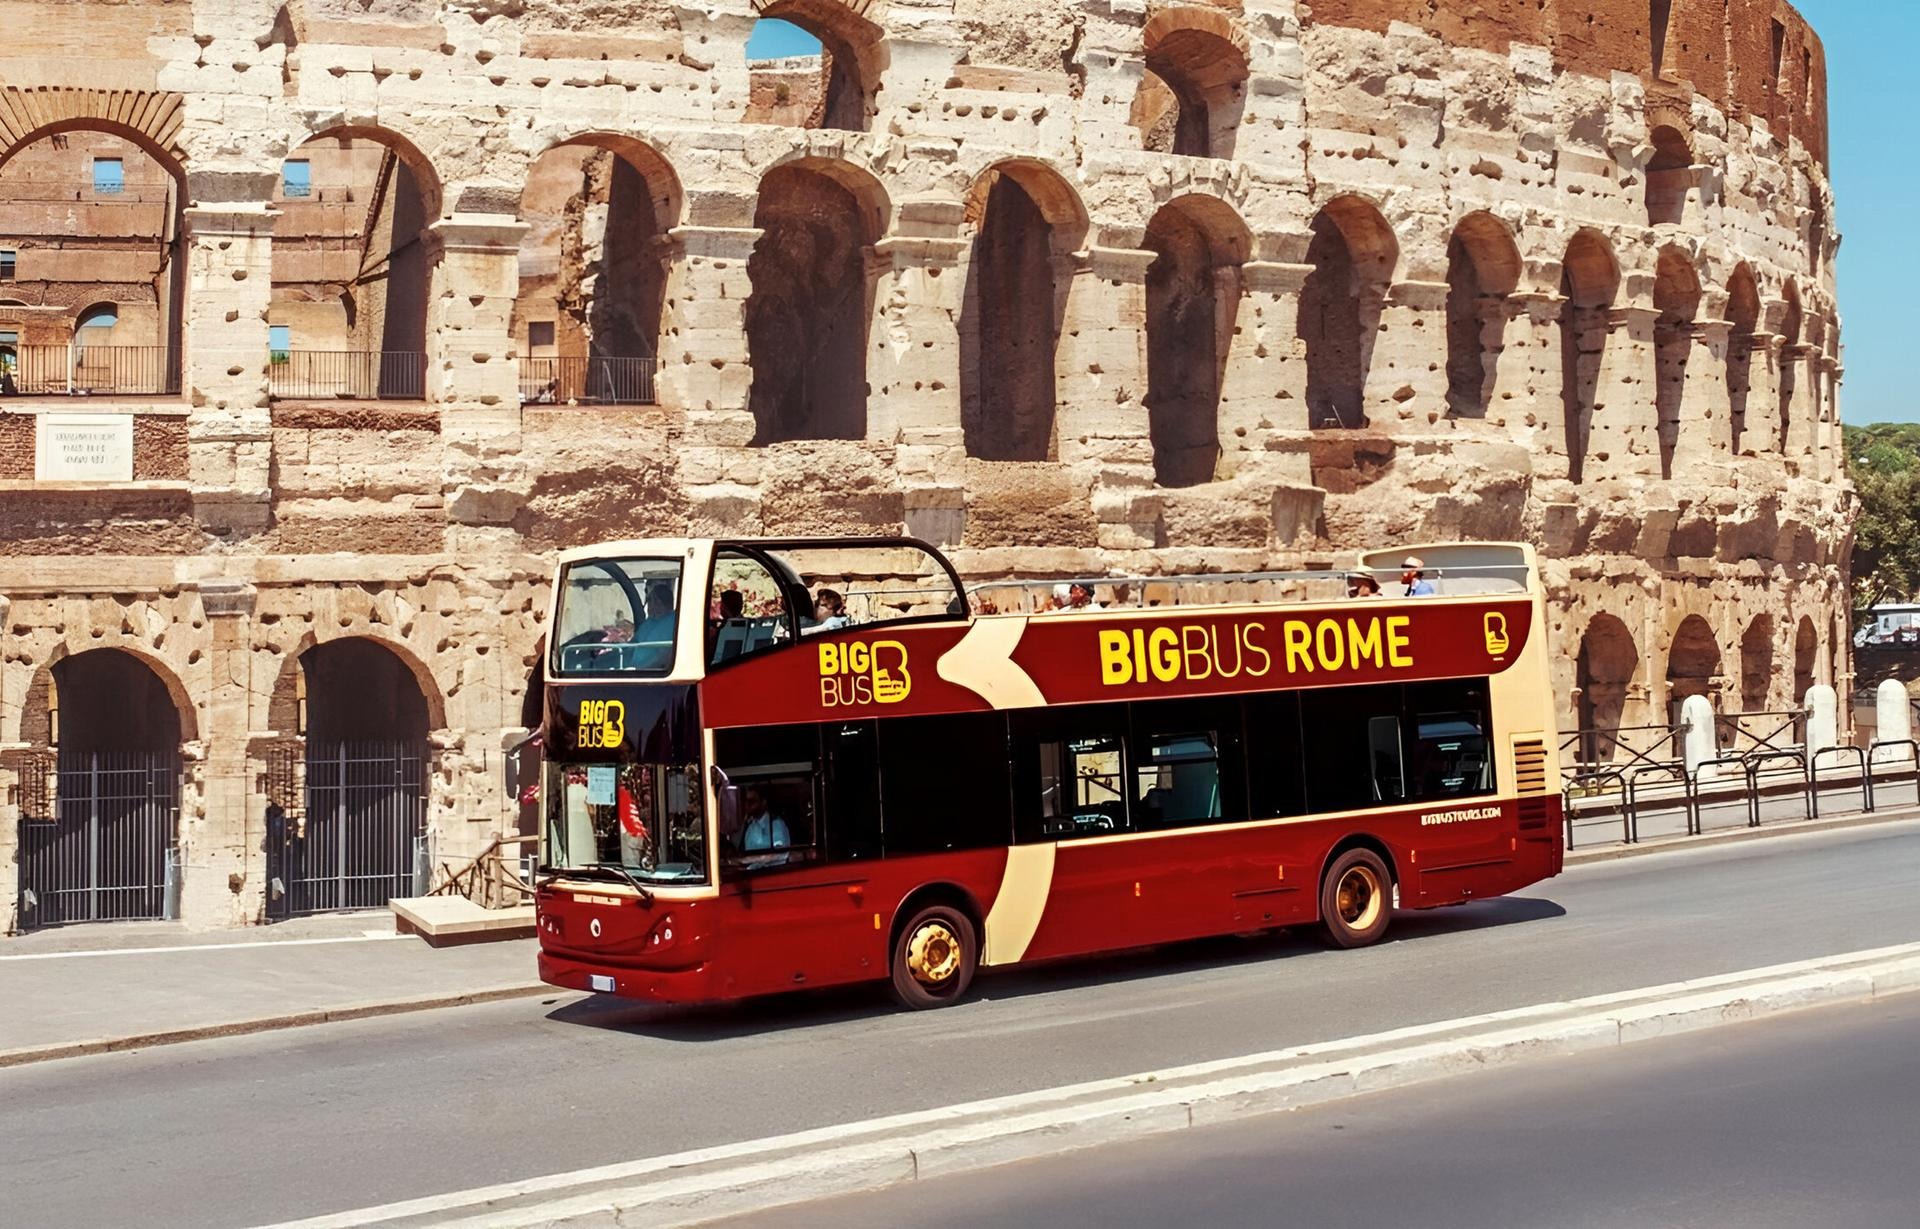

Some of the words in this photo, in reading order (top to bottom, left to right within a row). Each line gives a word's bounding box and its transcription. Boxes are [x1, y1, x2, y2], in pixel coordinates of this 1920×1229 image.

[818, 641, 870, 676] BIG
[1283, 616, 1414, 673] ROME
[820, 675, 872, 707] BUS
[579, 699, 605, 725] BIG
[577, 724, 604, 748] BUS
